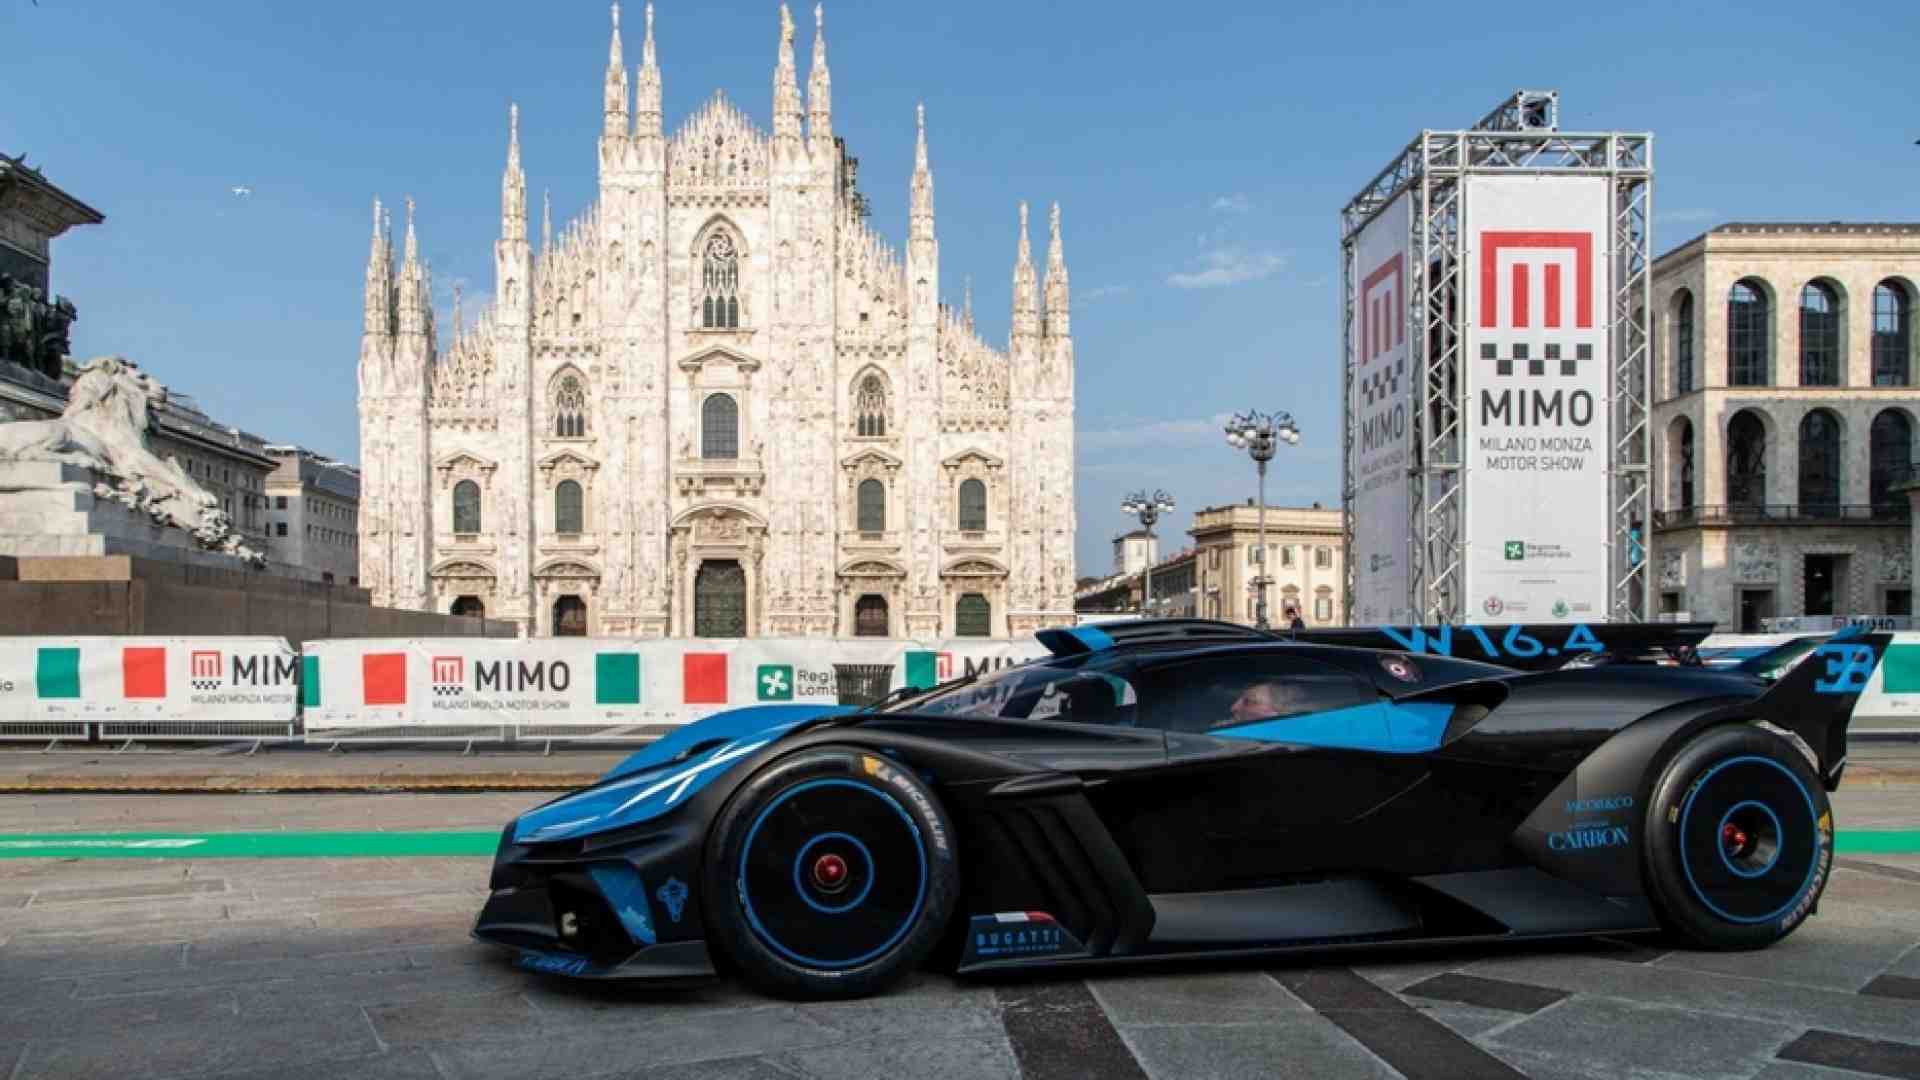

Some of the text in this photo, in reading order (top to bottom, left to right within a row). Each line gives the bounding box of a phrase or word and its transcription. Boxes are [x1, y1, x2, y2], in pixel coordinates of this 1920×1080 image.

[1481, 389, 1592, 426] MIMO
[1362, 403, 1405, 455] MIMO
[1480, 438, 1592, 451] MILANO MONZA
[1487, 456, 1584, 470] MOTOR SHOW
[232, 655, 296, 685] MIM
[475, 660, 571, 692] MIMO
[797, 670, 835, 683] Regi
[1546, 824, 1630, 849] CARBON
[976, 930, 1063, 945] BUGATTI
